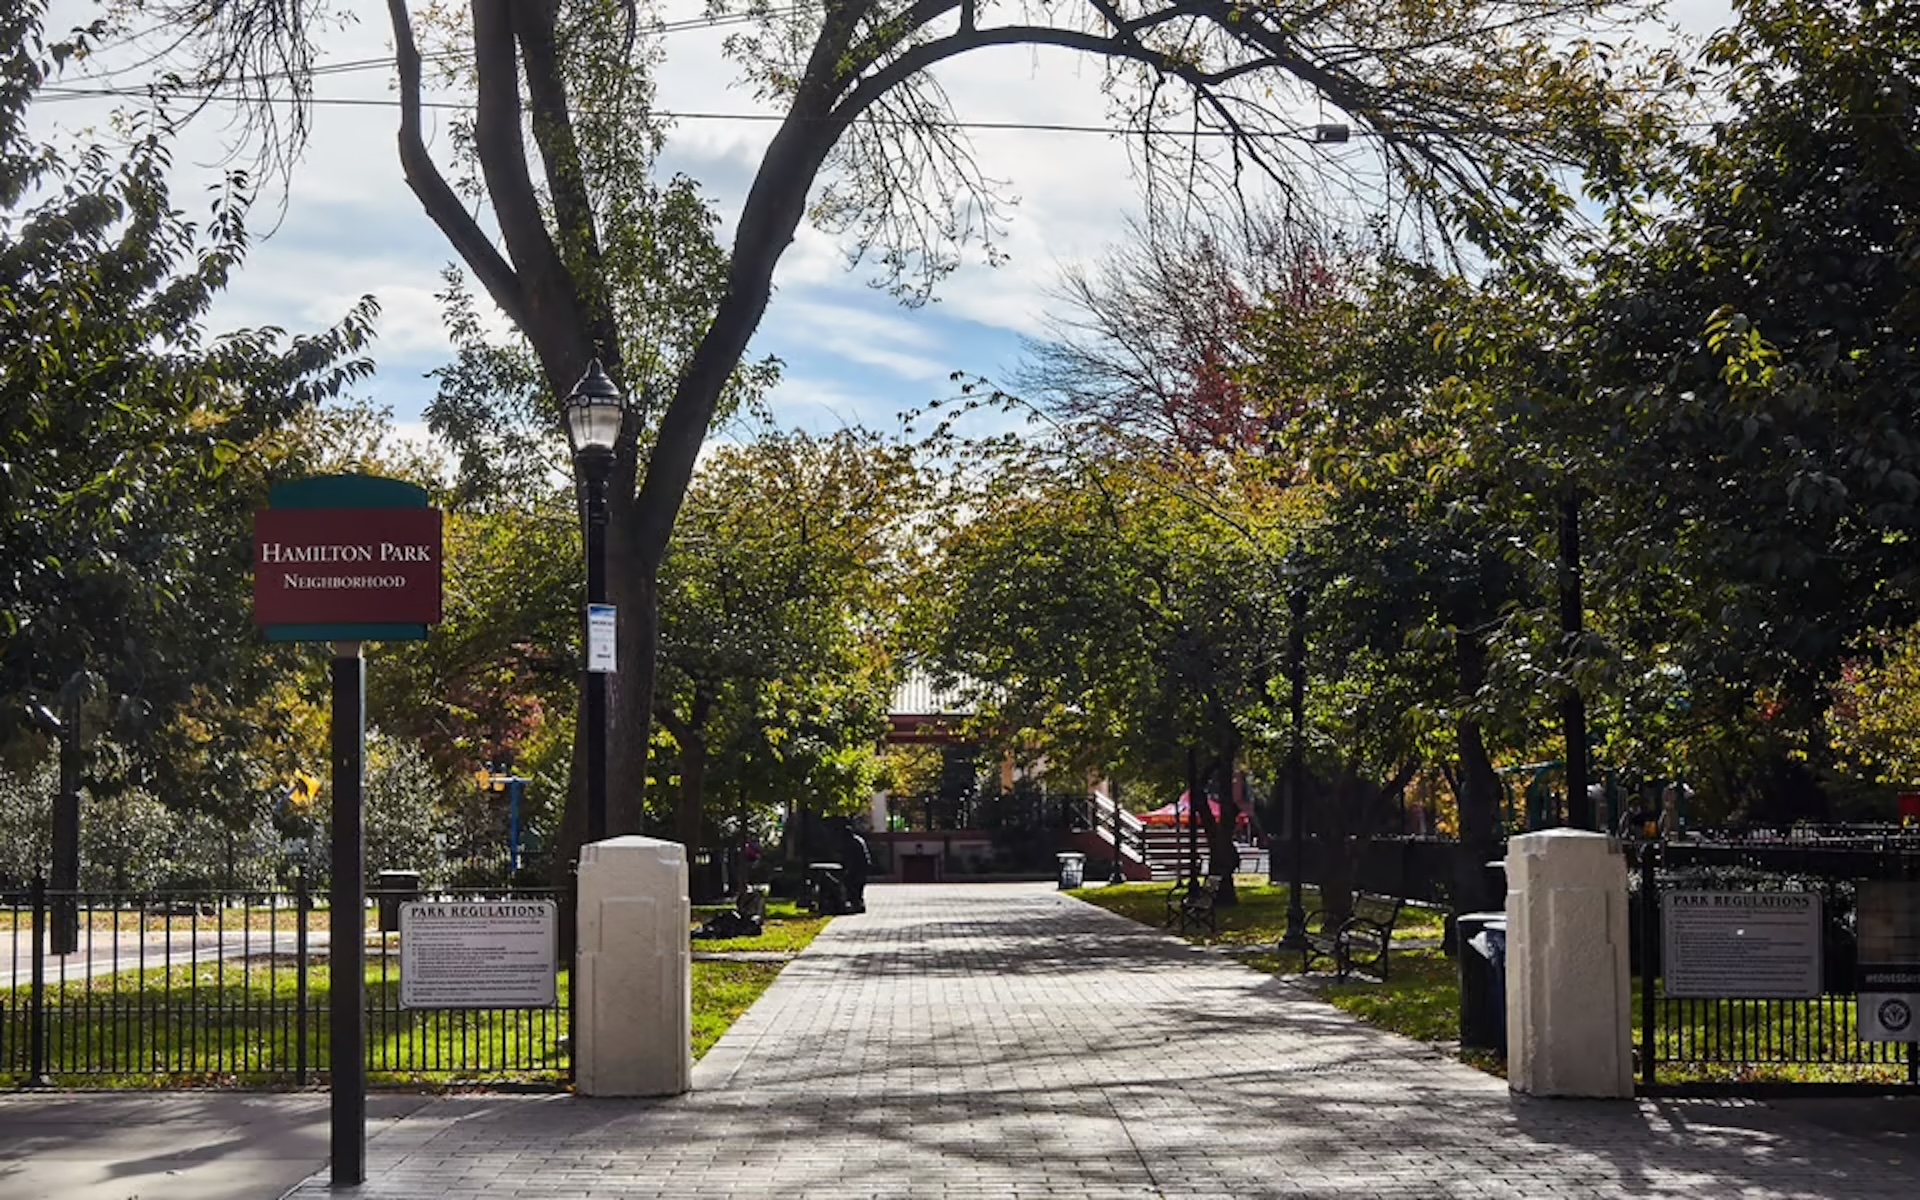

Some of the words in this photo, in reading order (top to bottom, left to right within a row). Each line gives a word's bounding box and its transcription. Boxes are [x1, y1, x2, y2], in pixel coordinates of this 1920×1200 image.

[262, 542, 372, 563] HAMILTON
[380, 542, 431, 563] PARK
[283, 573, 406, 589] NEIGHBORHOOD
[1673, 895, 1709, 907] PARK
[1714, 895, 1810, 908] REGULATIONS
[411, 906, 445, 918] PARK
[451, 906, 545, 918] REGULATIONS
